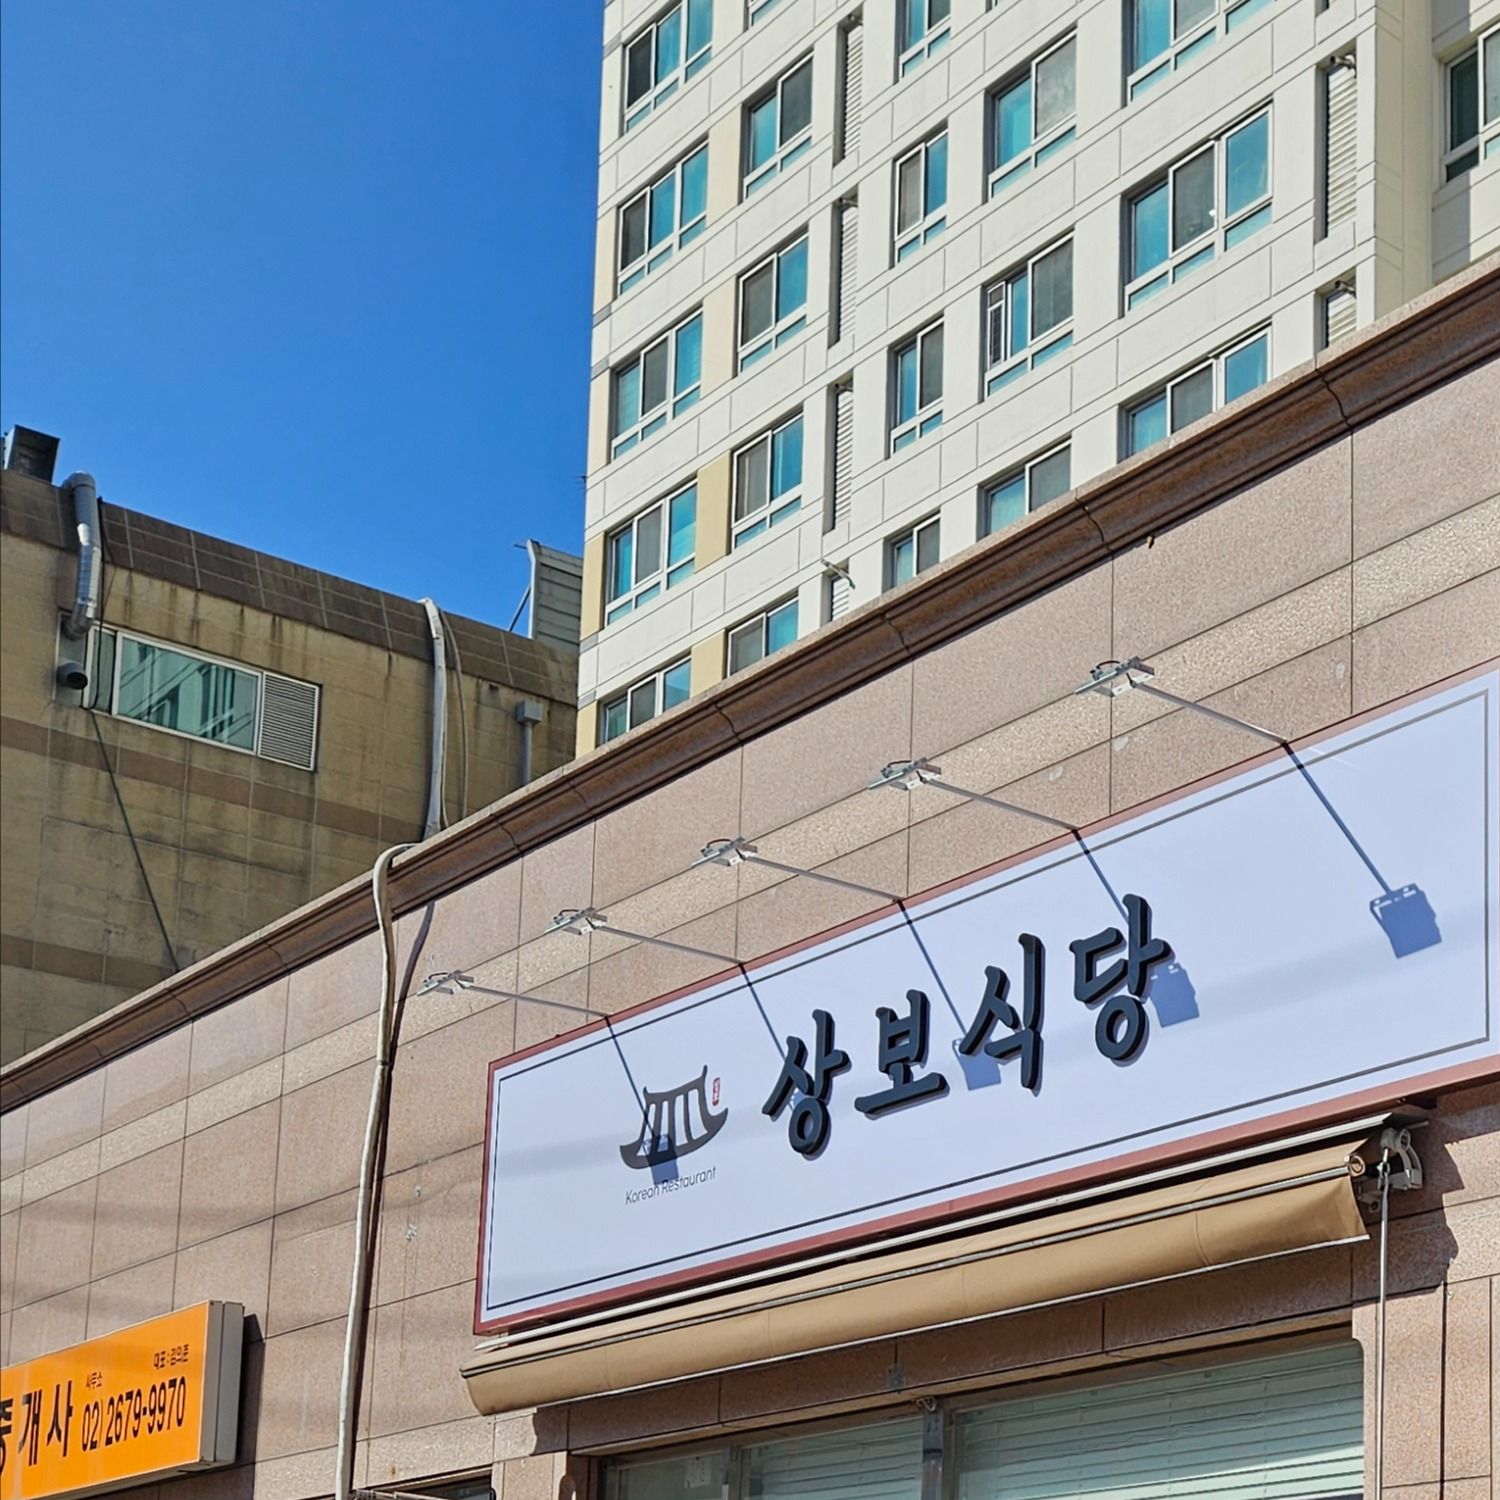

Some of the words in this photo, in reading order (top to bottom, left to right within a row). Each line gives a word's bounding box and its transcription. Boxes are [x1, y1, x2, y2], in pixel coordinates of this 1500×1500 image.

[762, 893, 1174, 1159] 상보식당
[625, 1179, 660, 1205] Korean
[661, 1166, 717, 1196] Restaurant
